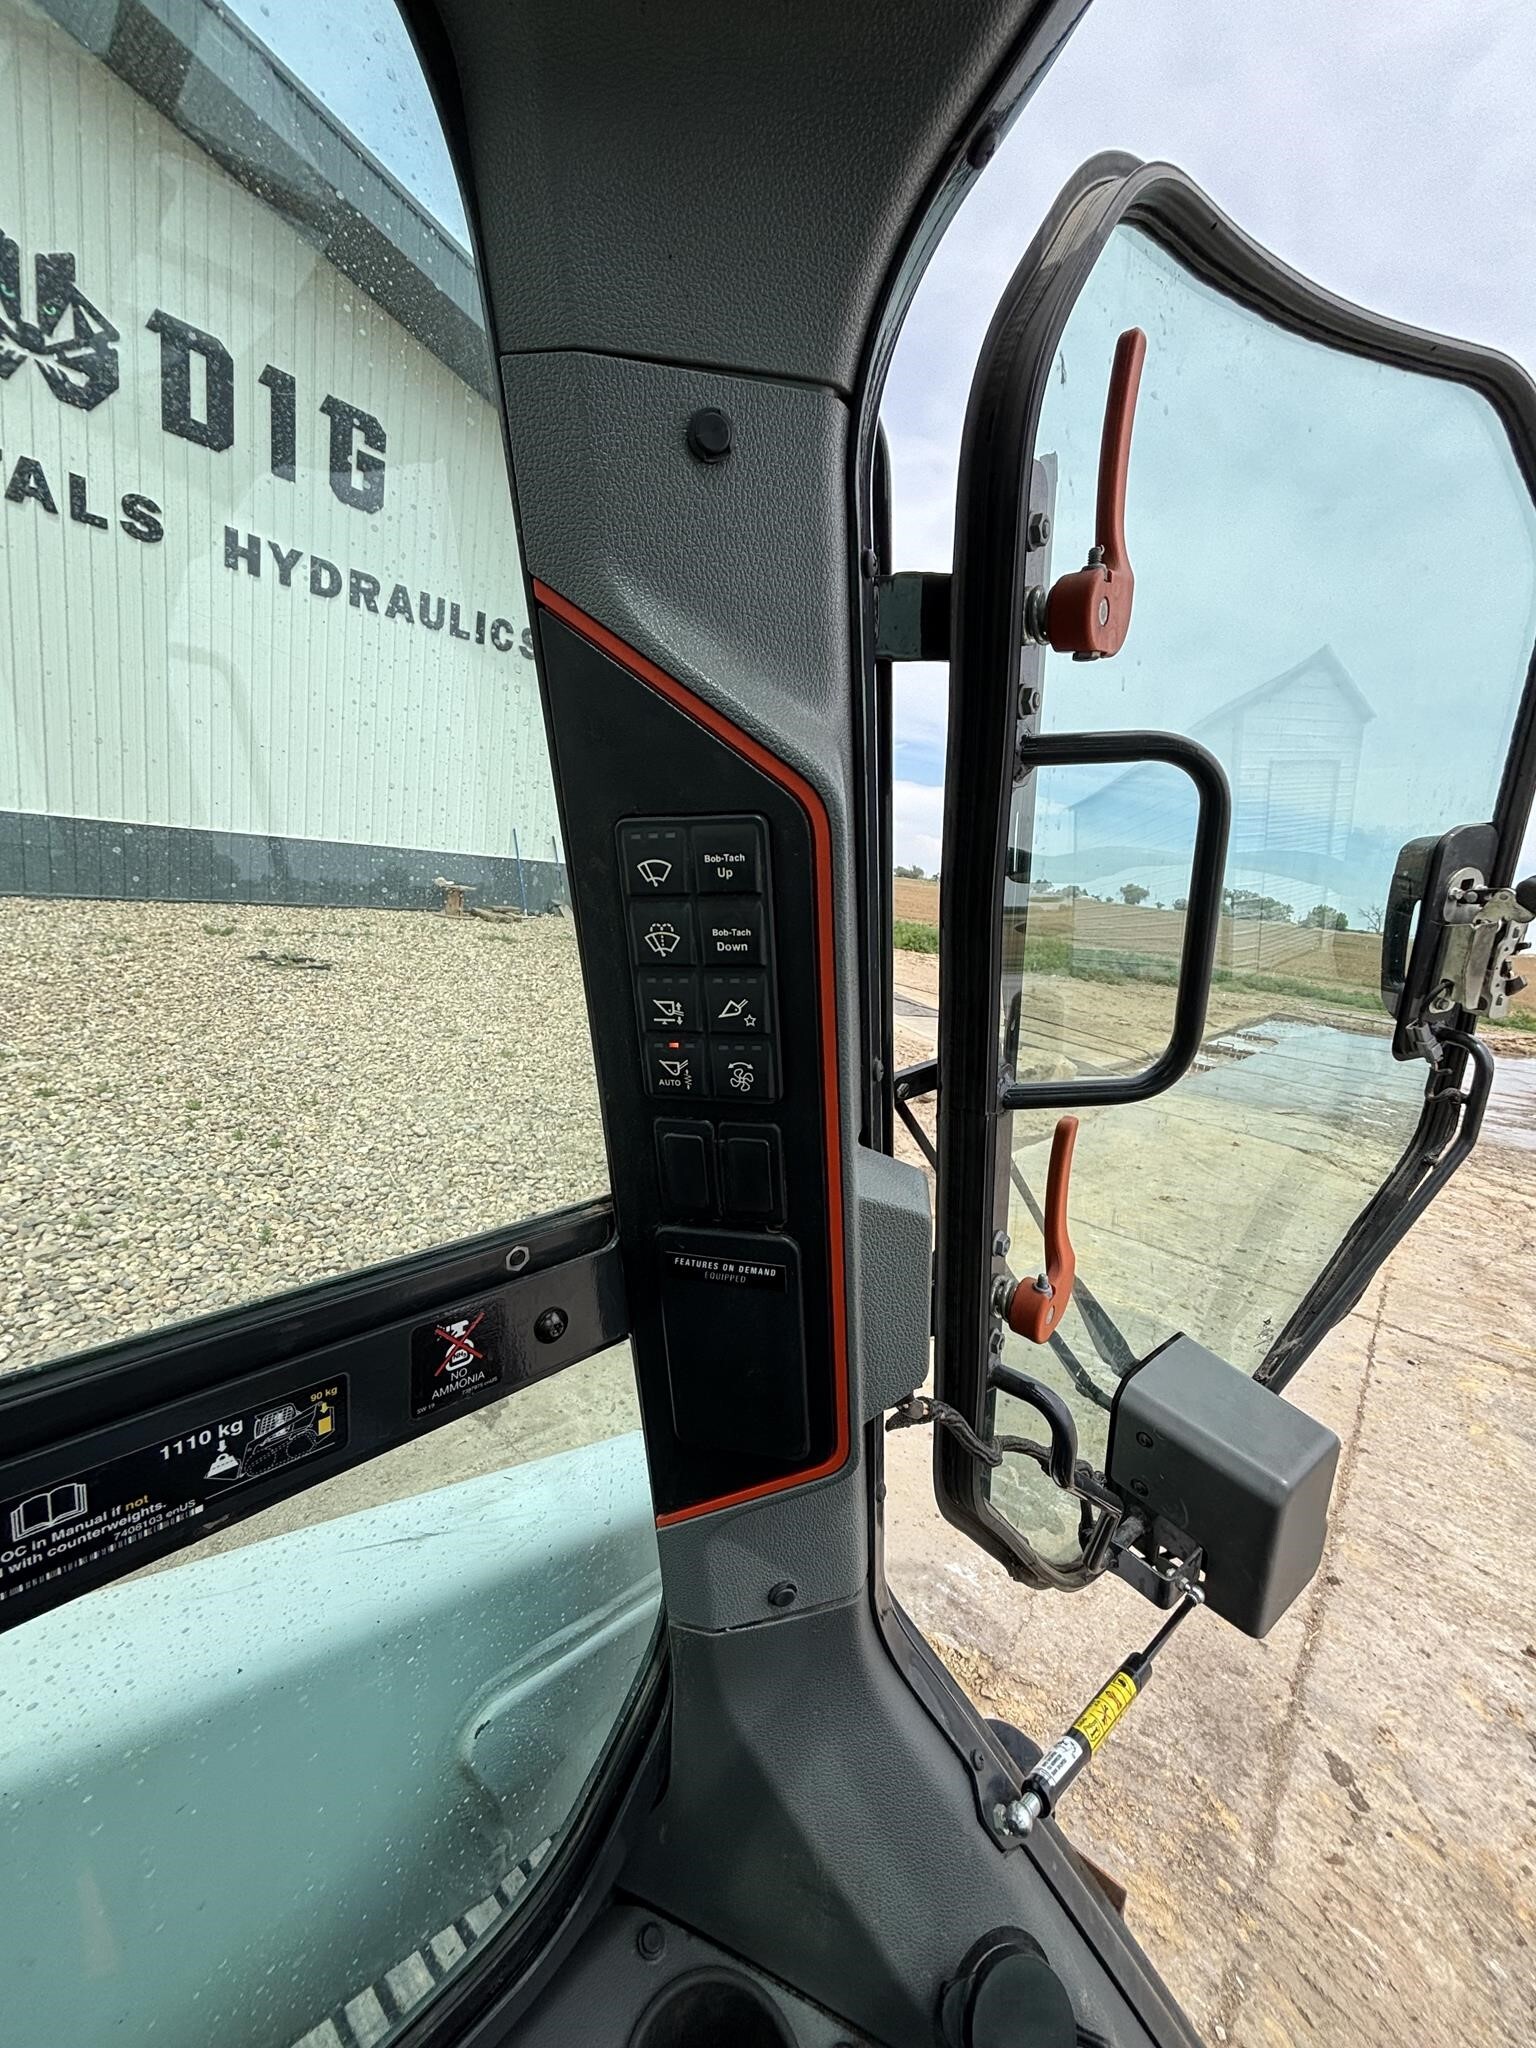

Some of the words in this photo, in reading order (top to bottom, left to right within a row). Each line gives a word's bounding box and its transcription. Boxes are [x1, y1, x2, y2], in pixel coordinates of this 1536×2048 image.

[0, 449, 164, 543] ALS
[704, 853, 746, 863] Bob-Tach
[717, 867, 733, 880] Up
[712, 928, 752, 937] Bob-Tach
[716, 941, 748, 952] Down
[658, 1079, 682, 1087] AUTO
[674, 1257, 719, 1270] FEATURES
[722, 1263, 735, 1272] ON
[738, 1265, 777, 1277] DEMAND
[704, 1271, 747, 1283] EQUIPPED
[450, 1367, 468, 1382] NO
[431, 1370, 485, 1400] AMMONIA
[310, 1391, 323, 1402] 90
[325, 1386, 338, 1397] kg
[159, 1430, 212, 1460] 1110
[218, 1419, 244, 1438] kg
[165, 1499, 196, 1518] enUS
[31, 1538, 47, 1551] in
[51, 1511, 108, 1543] Manual
[111, 1504, 122, 1518] if
[125, 1494, 149, 1511] not
[8, 1553, 43, 1573] with
[47, 1502, 167, 1557] counterweights.
